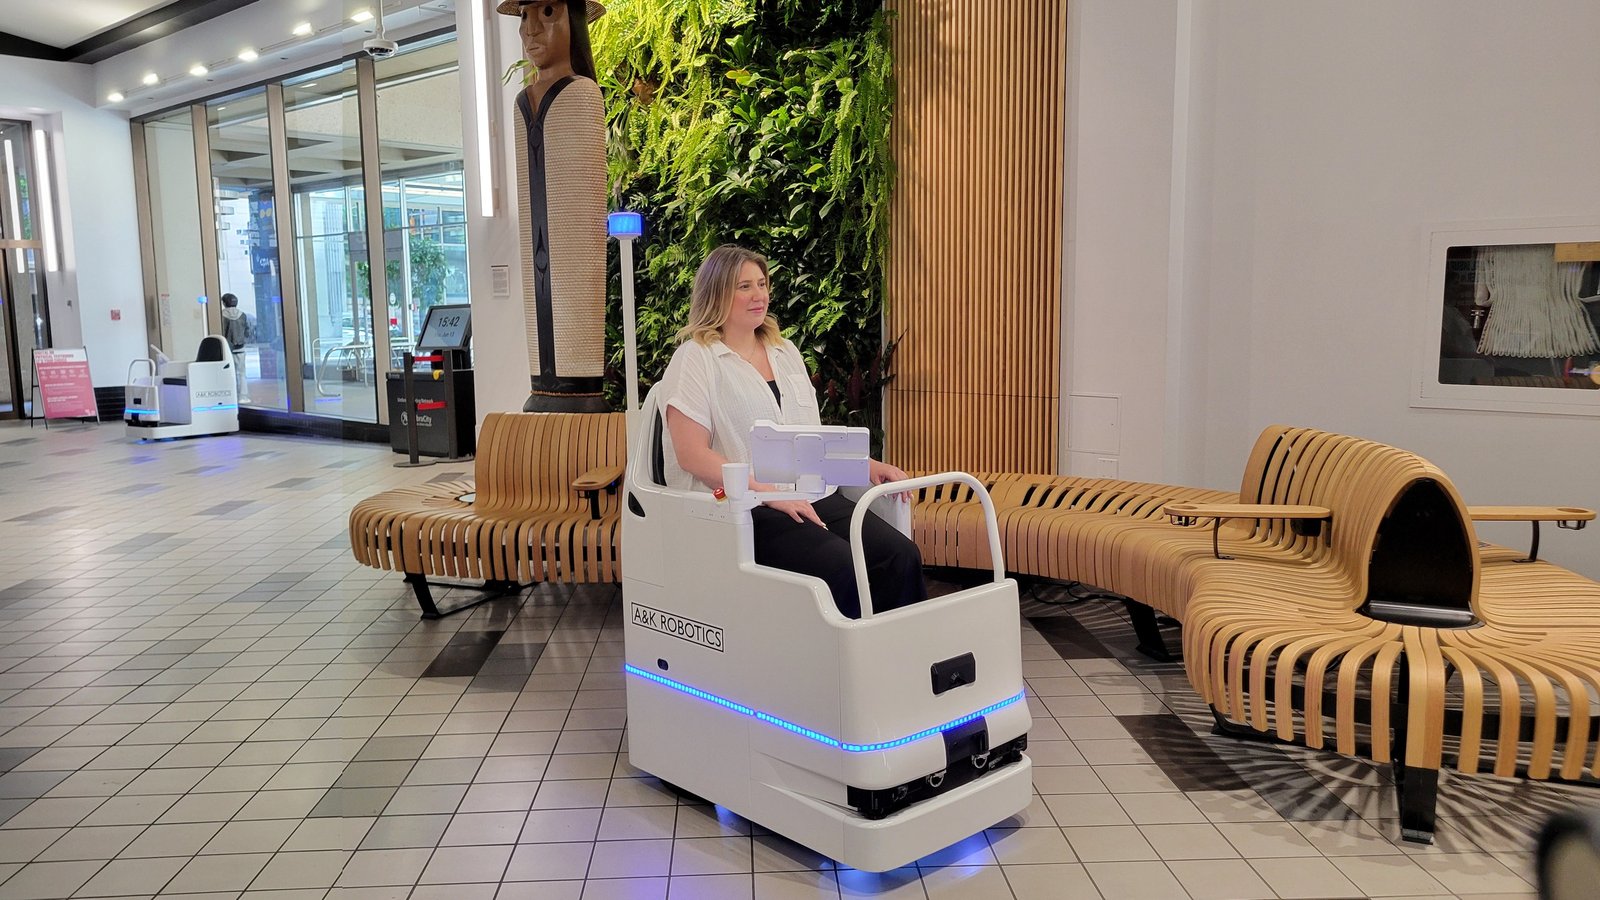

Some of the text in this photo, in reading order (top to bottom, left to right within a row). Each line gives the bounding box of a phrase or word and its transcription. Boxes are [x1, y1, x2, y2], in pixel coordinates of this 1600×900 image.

[438, 316, 460, 327] 15:42
[634, 607, 721, 647] A&K ROBOTICS
